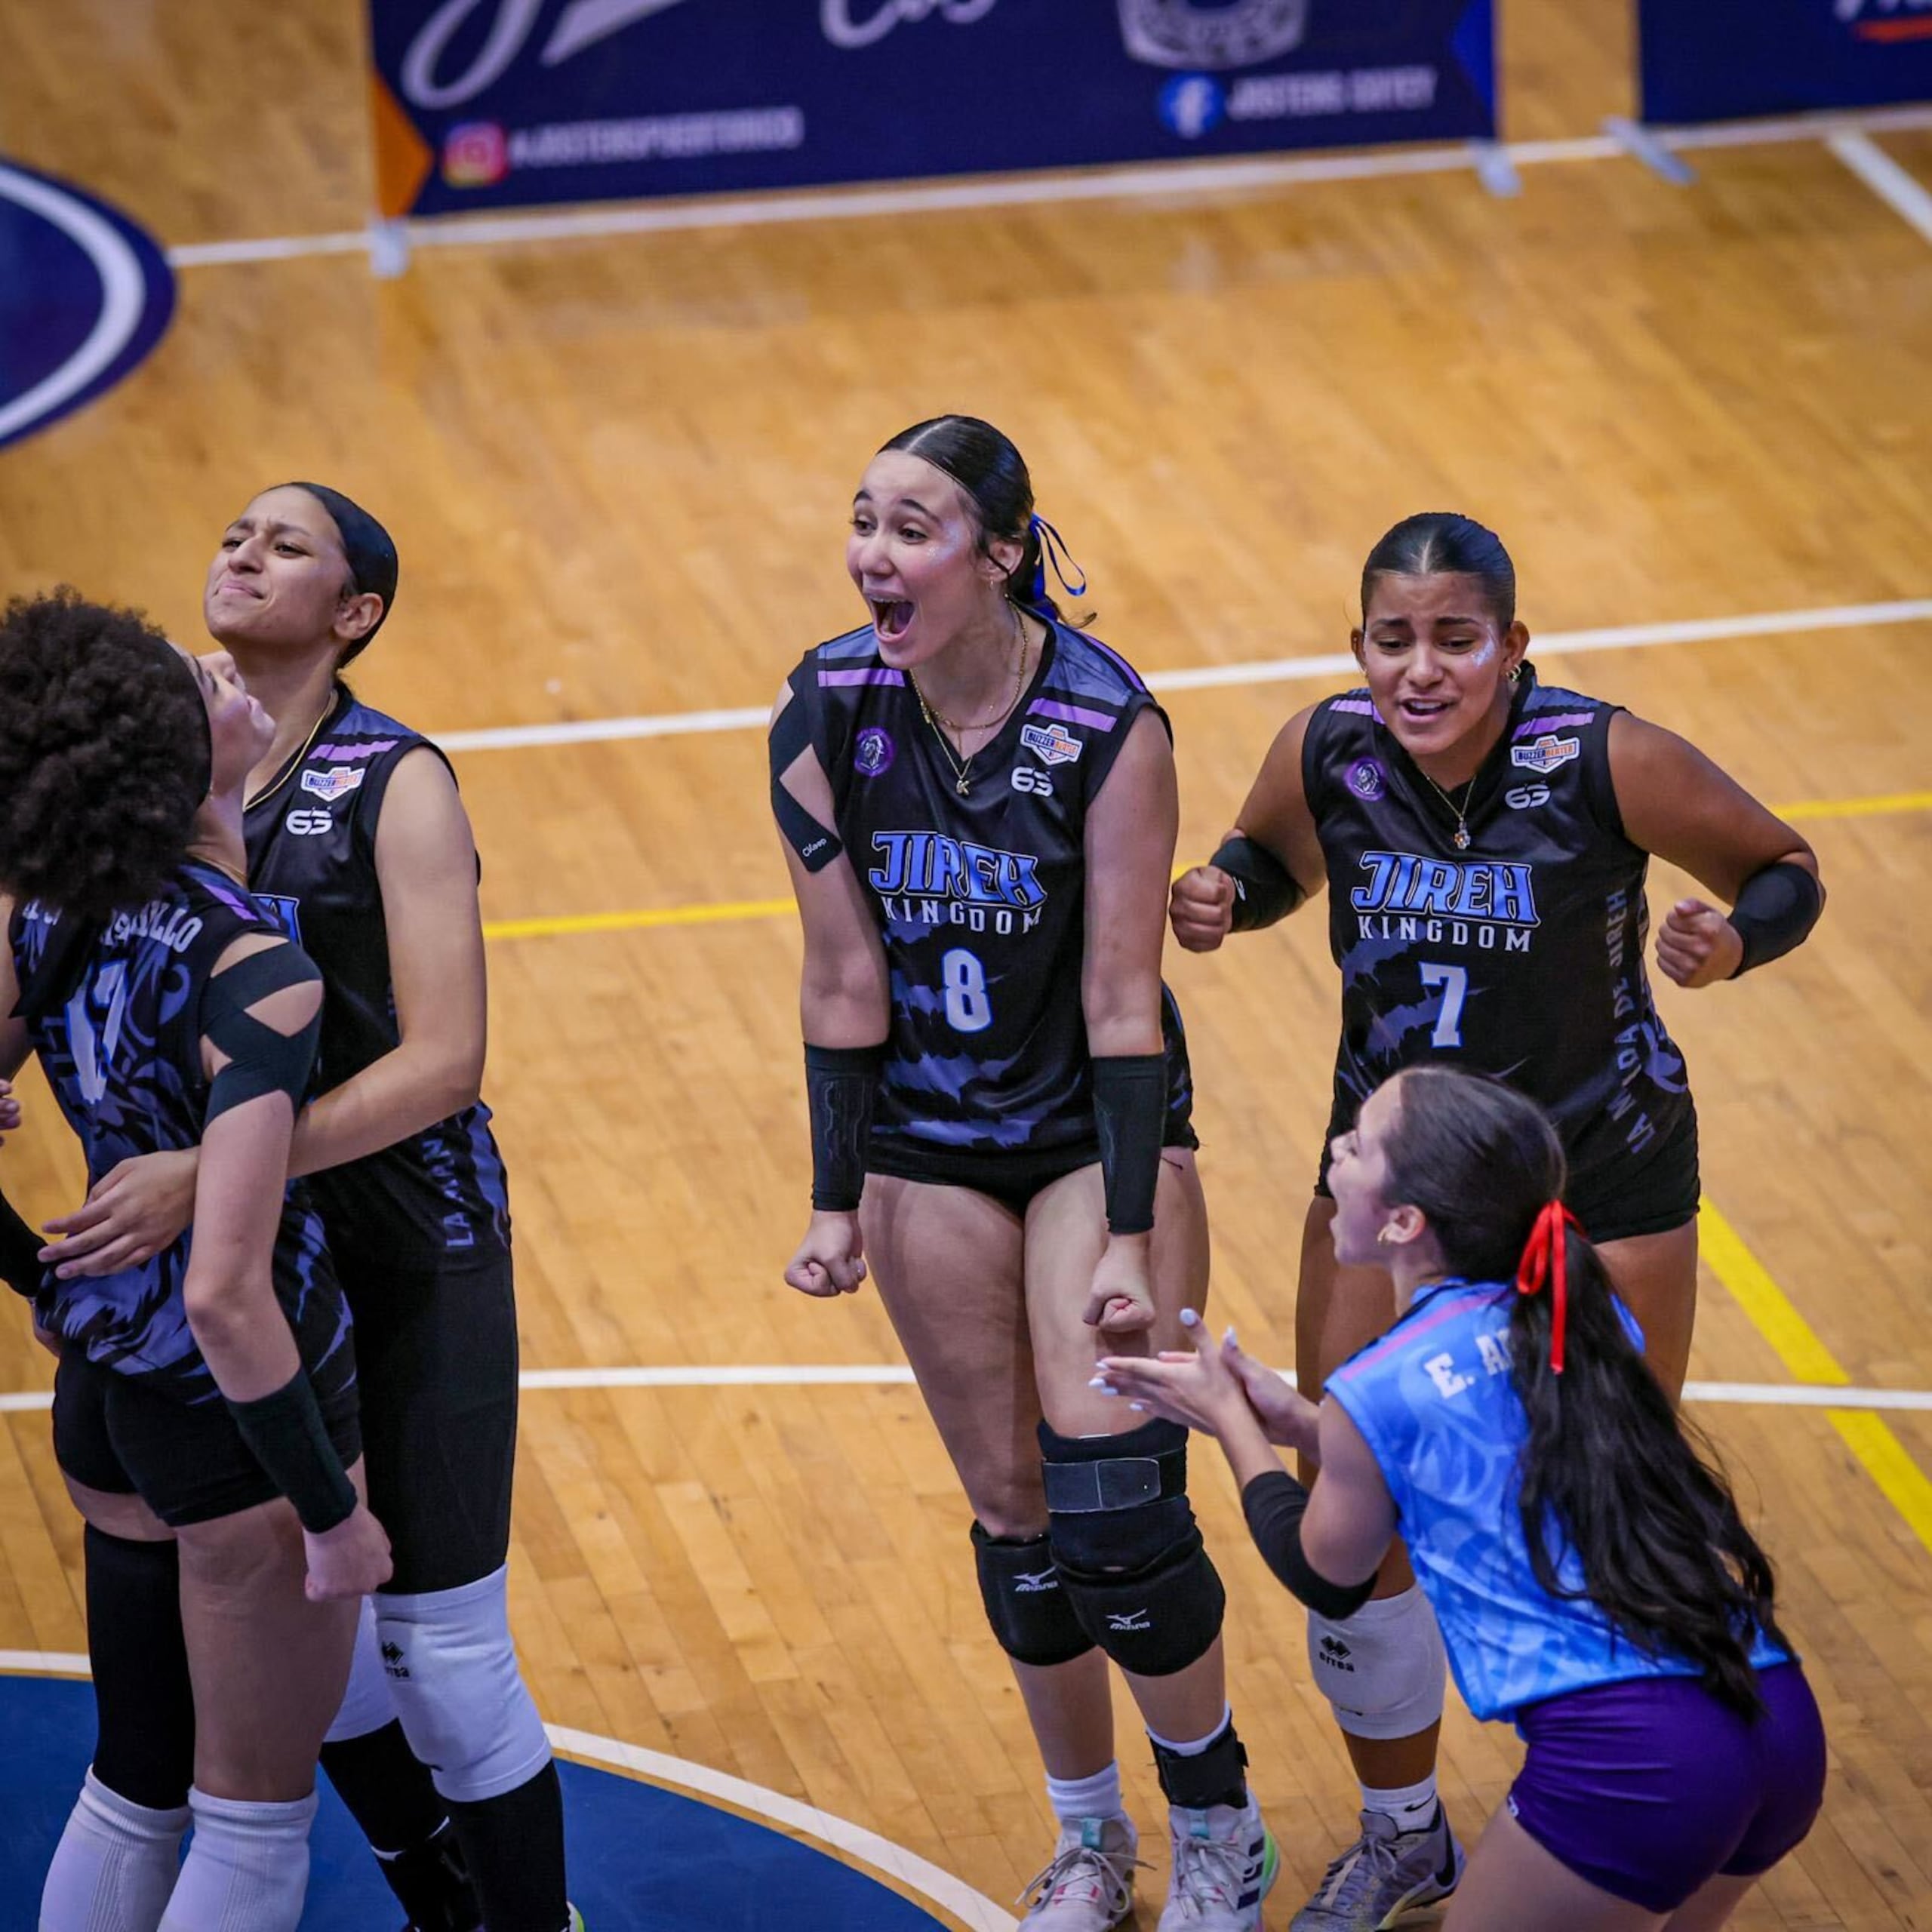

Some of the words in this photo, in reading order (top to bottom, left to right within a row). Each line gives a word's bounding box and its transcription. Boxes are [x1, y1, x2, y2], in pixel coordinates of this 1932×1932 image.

[869, 830, 1048, 911] JIREH
[1350, 851, 1541, 928] JIREH
[881, 896, 1043, 935] KINGDOM
[1358, 915, 1531, 953] KINGDOM
[941, 947, 992, 1033] 8
[1418, 961, 1469, 1049] 7
[1424, 1352, 1475, 1400] E.
